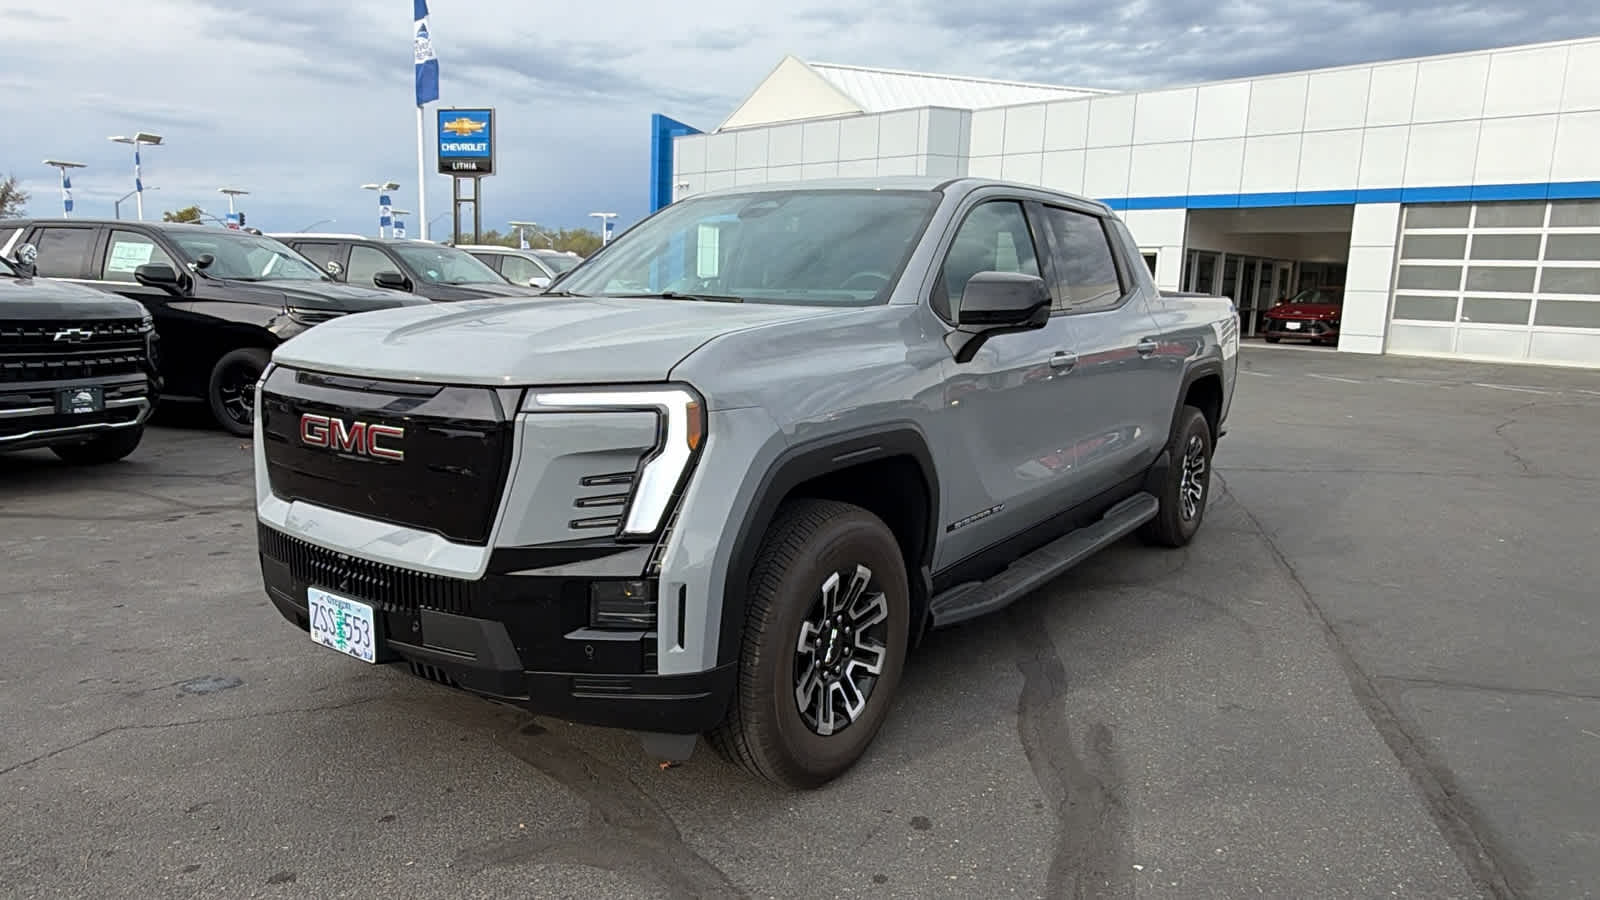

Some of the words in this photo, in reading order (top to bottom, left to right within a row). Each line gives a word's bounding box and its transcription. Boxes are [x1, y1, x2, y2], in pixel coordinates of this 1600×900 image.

[441, 143, 487, 152] CHEVROLET
[452, 162, 477, 170] LITHIA
[301, 413, 404, 461] GMC
[311, 602, 336, 635] ZSS
[344, 613, 370, 648] 553
